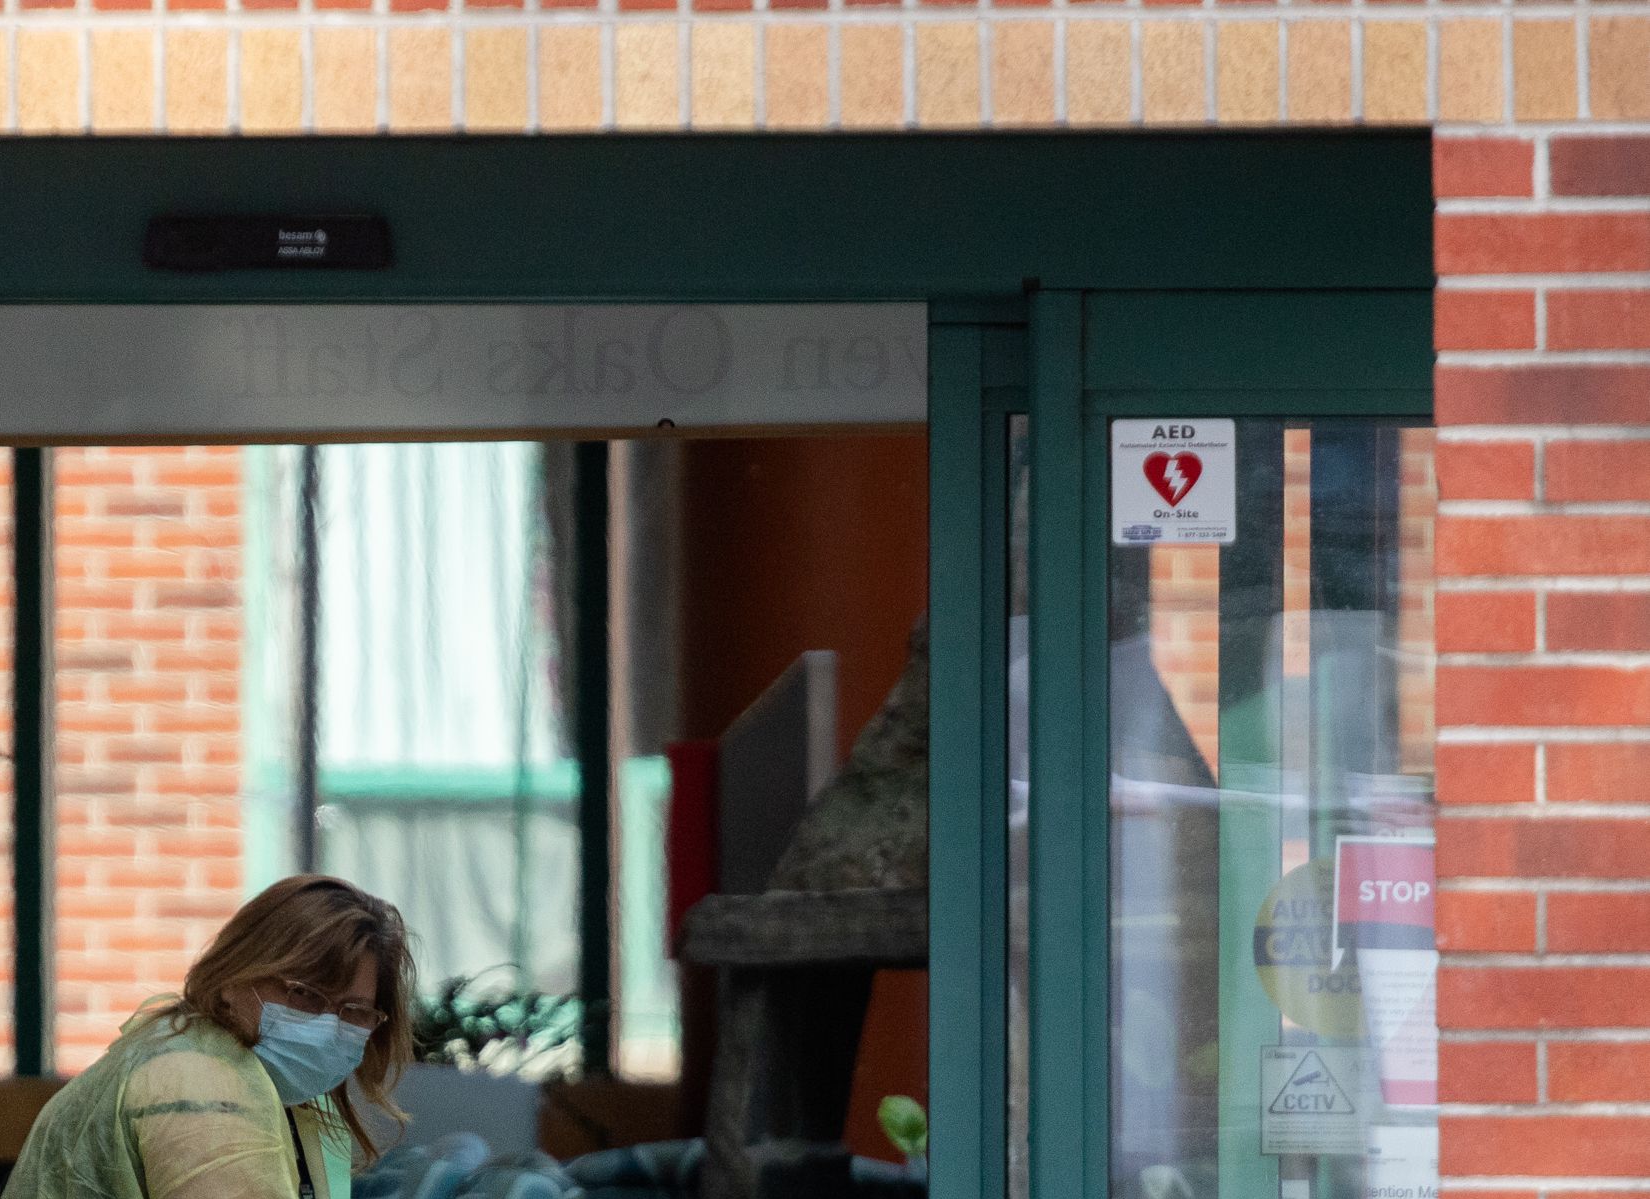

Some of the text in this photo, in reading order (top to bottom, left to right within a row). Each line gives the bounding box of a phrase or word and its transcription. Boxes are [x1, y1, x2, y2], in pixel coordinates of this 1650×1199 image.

[1152, 425, 1195, 439] AED
[1153, 509, 1199, 518] On-Site
[1359, 880, 1431, 903] STOP
[1283, 1093, 1336, 1110] CCTV
[1366, 1187, 1413, 1199] ention
